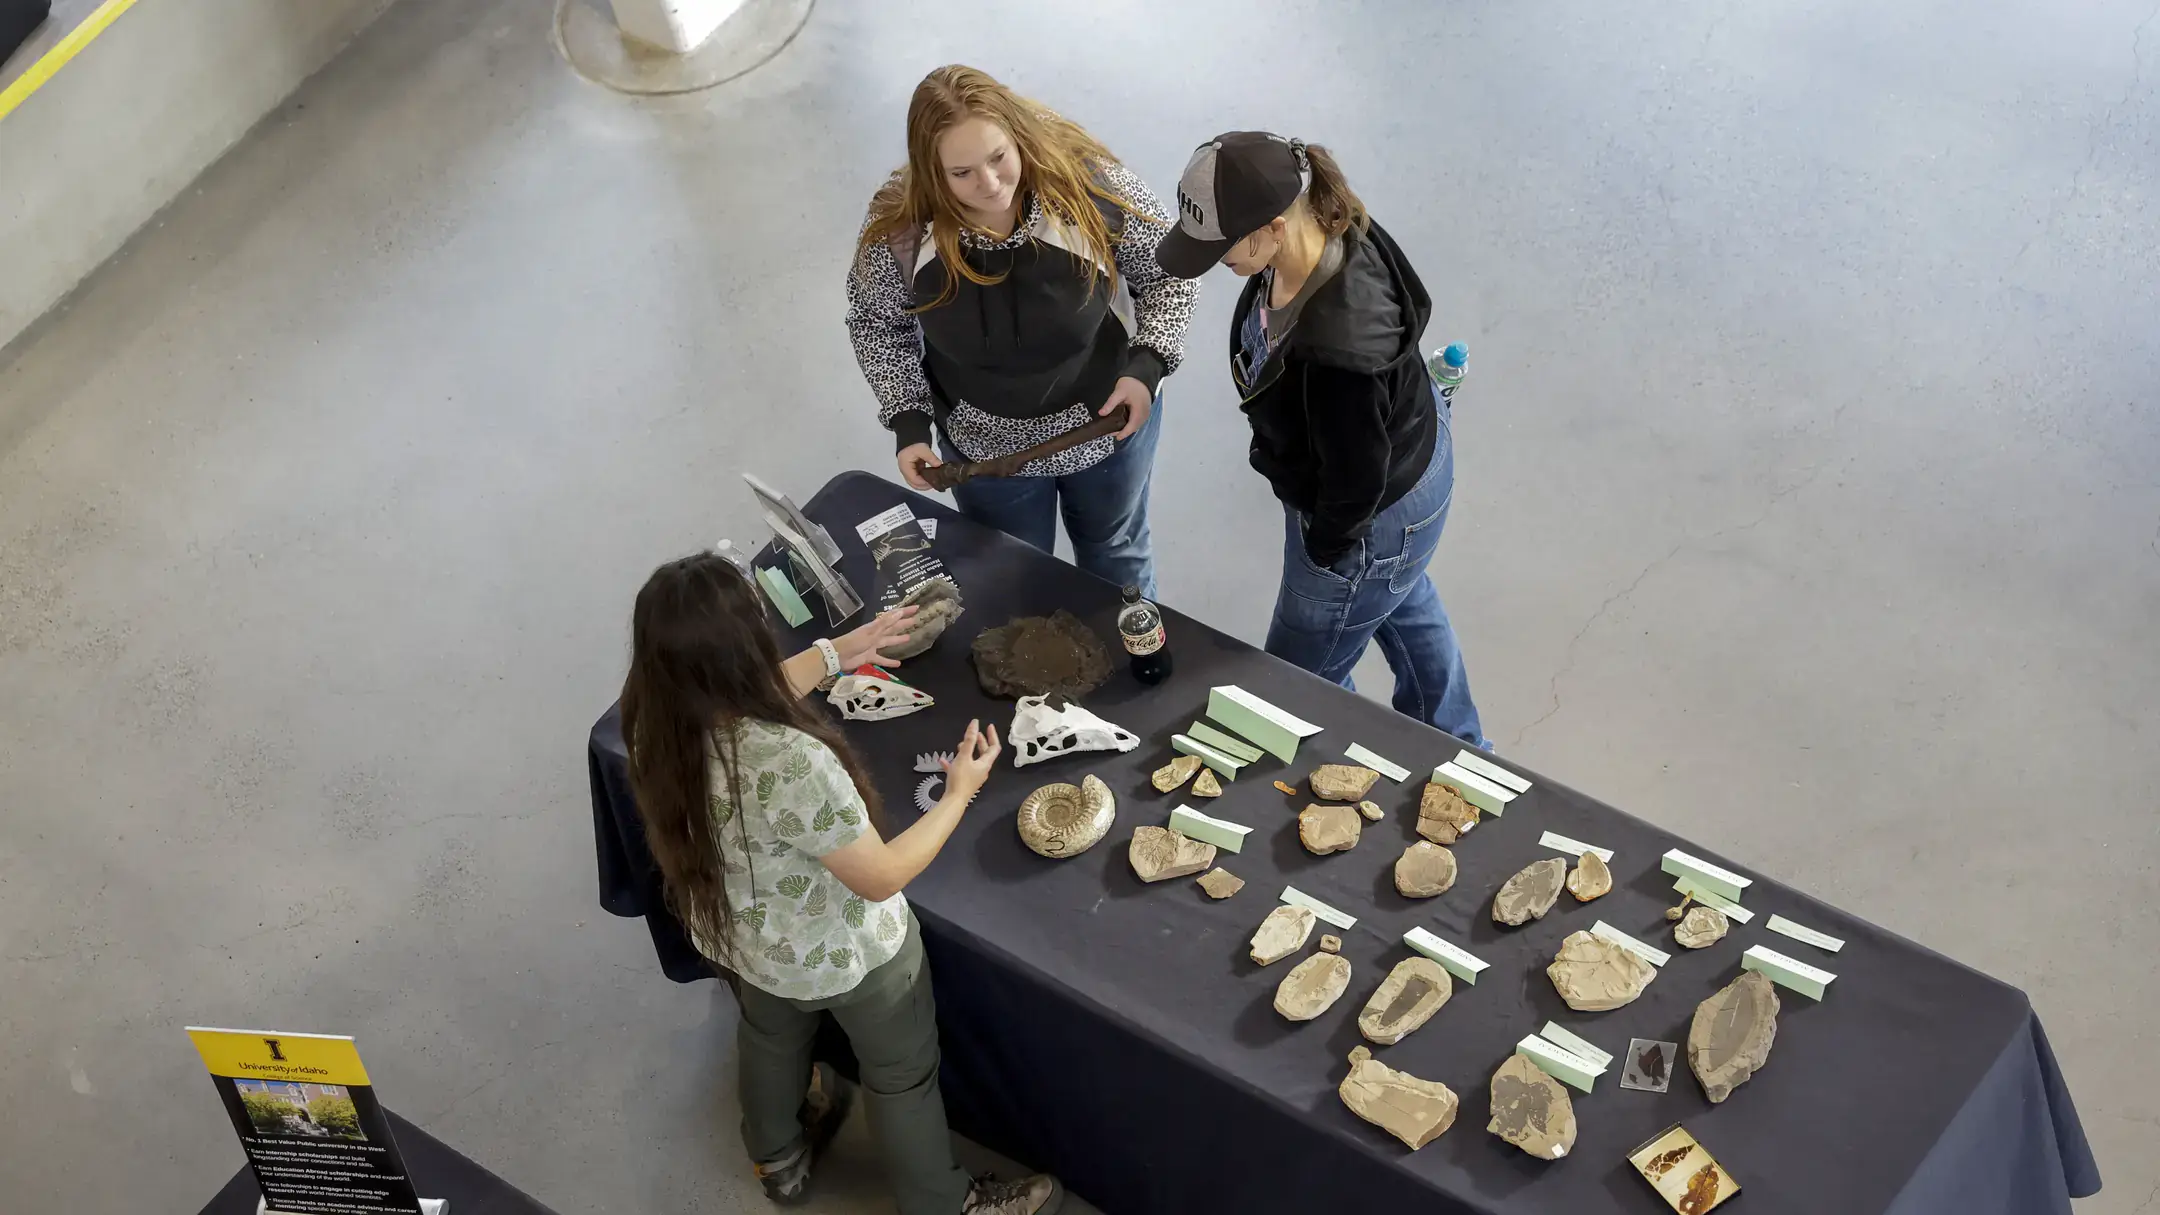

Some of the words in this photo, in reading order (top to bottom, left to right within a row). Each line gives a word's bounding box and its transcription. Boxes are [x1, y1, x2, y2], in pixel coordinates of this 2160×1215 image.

[920, 559, 940, 570] Natural
[926, 562, 944, 572] Idaho
[900, 568, 920, 580] History
[903, 570, 927, 583] Museum
[238, 1062, 290, 1074] University
[299, 1066, 328, 1076] Idaho
[299, 1152, 338, 1160] scholarships
[274, 1172, 315, 1180] understanding
[329, 1170, 369, 1178] scholarships
